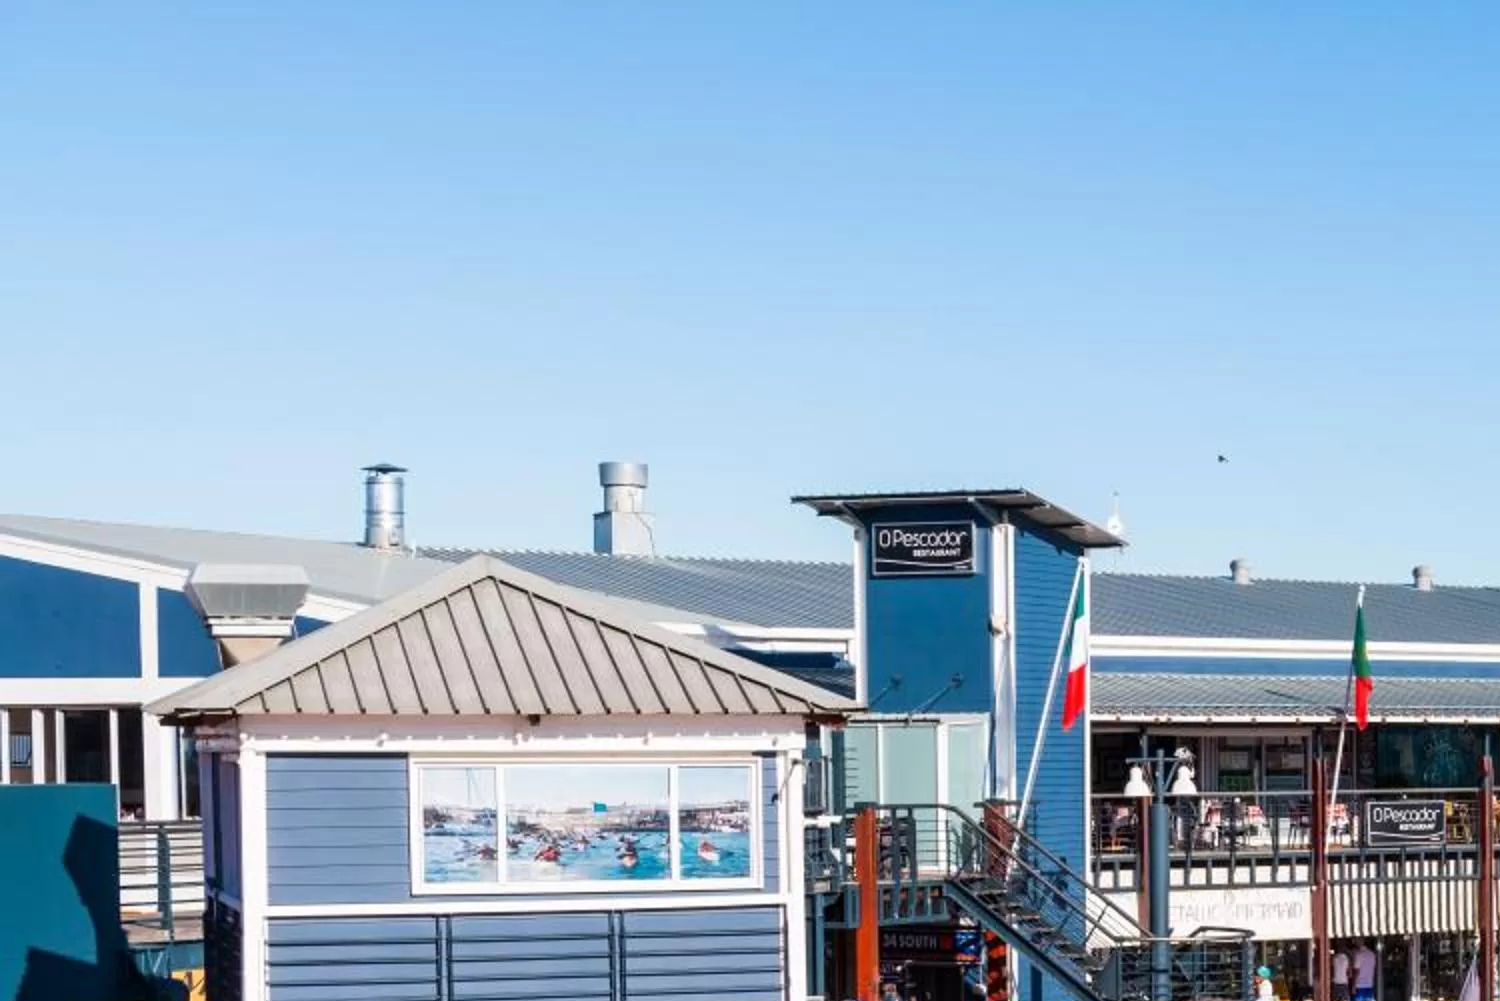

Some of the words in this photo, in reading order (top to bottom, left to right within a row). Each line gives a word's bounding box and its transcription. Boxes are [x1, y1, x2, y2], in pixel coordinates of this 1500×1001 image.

[893, 529, 968, 547] Pescador
[1384, 806, 1440, 823] Pescador
[899, 934, 937, 949] SOUTH
